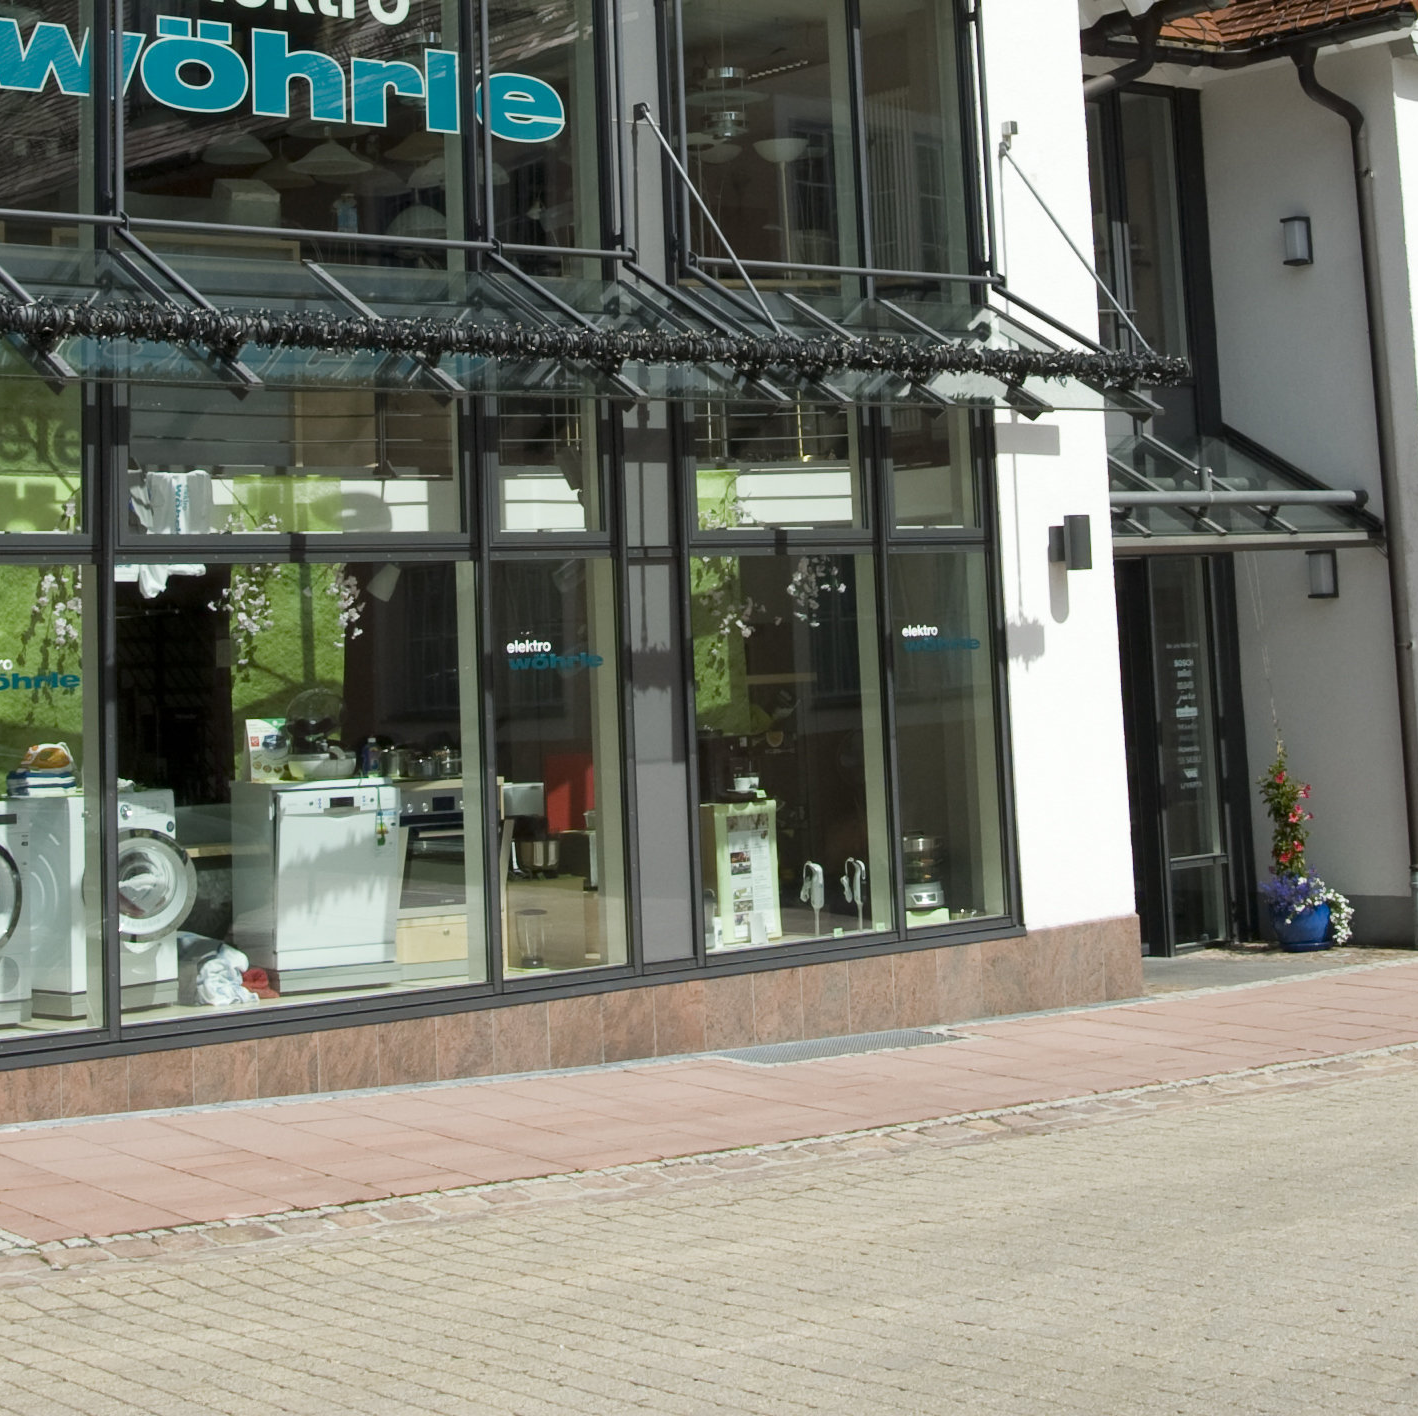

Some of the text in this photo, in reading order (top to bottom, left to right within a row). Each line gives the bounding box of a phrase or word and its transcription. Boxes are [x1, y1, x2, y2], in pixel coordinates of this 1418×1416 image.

[902, 625, 938, 637] elektro
[506, 639, 552, 654] elektro
[507, 652, 604, 671] wöhrle
